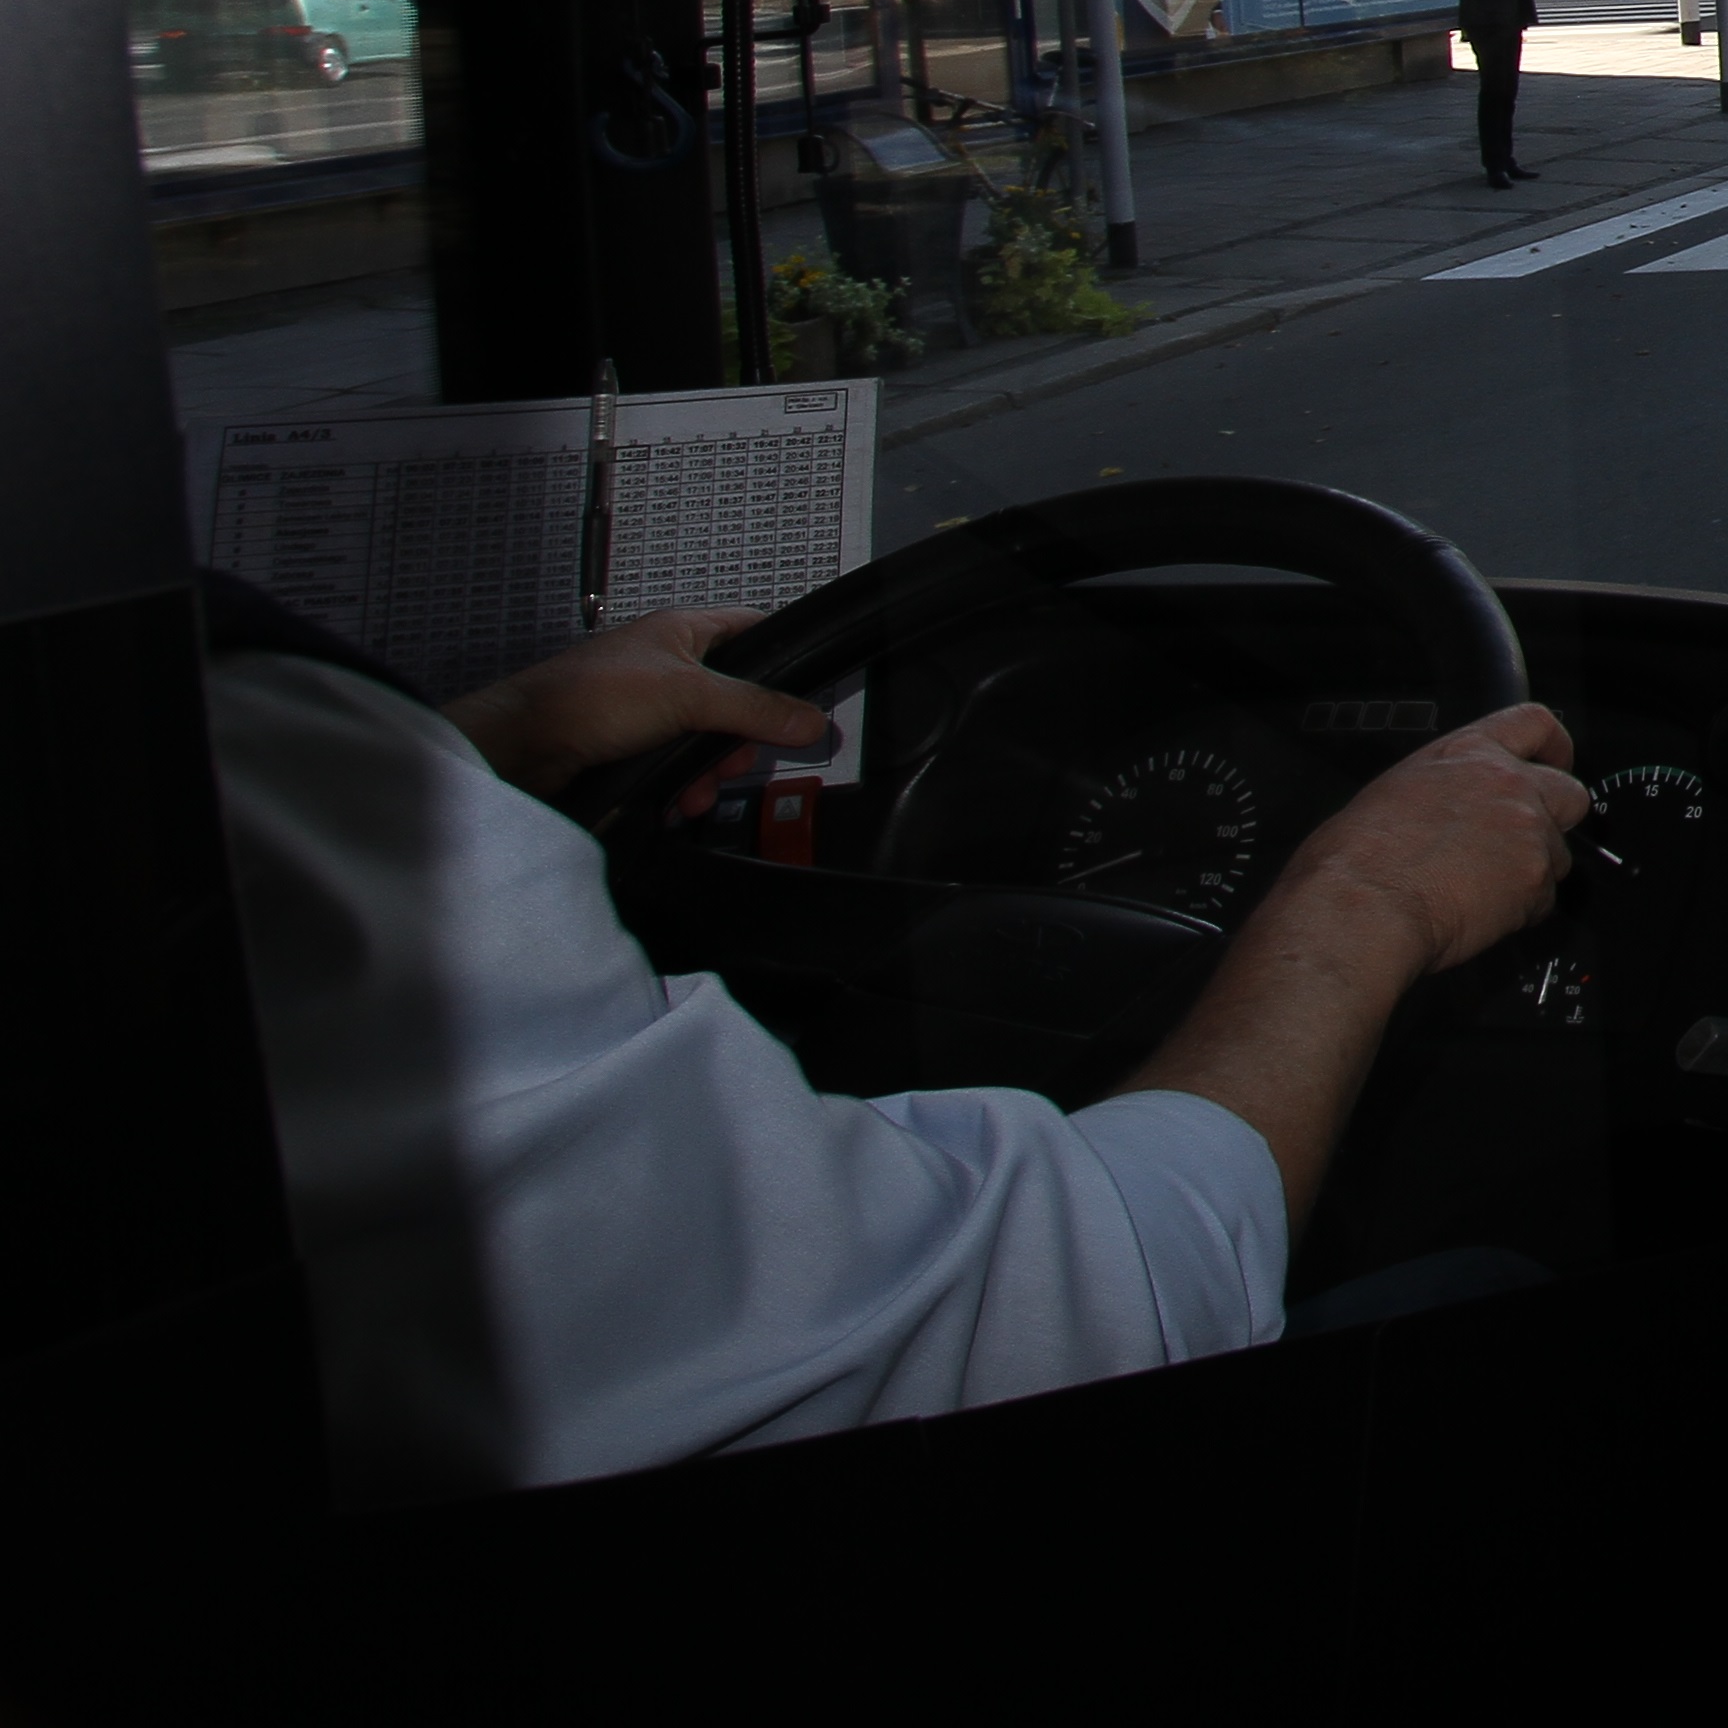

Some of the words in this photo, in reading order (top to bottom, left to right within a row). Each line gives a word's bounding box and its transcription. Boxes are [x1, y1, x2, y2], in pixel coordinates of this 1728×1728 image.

[1168, 768, 1186, 782] 60
[1119, 787, 1138, 800] 40
[1206, 783, 1224, 796] 80
[1643, 784, 1661, 798] 15
[1592, 802, 1609, 815] 10
[1684, 805, 1704, 819] 20
[1083, 831, 1103, 844] 20
[1215, 825, 1239, 839] 100
[1199, 872, 1223, 886] 120
